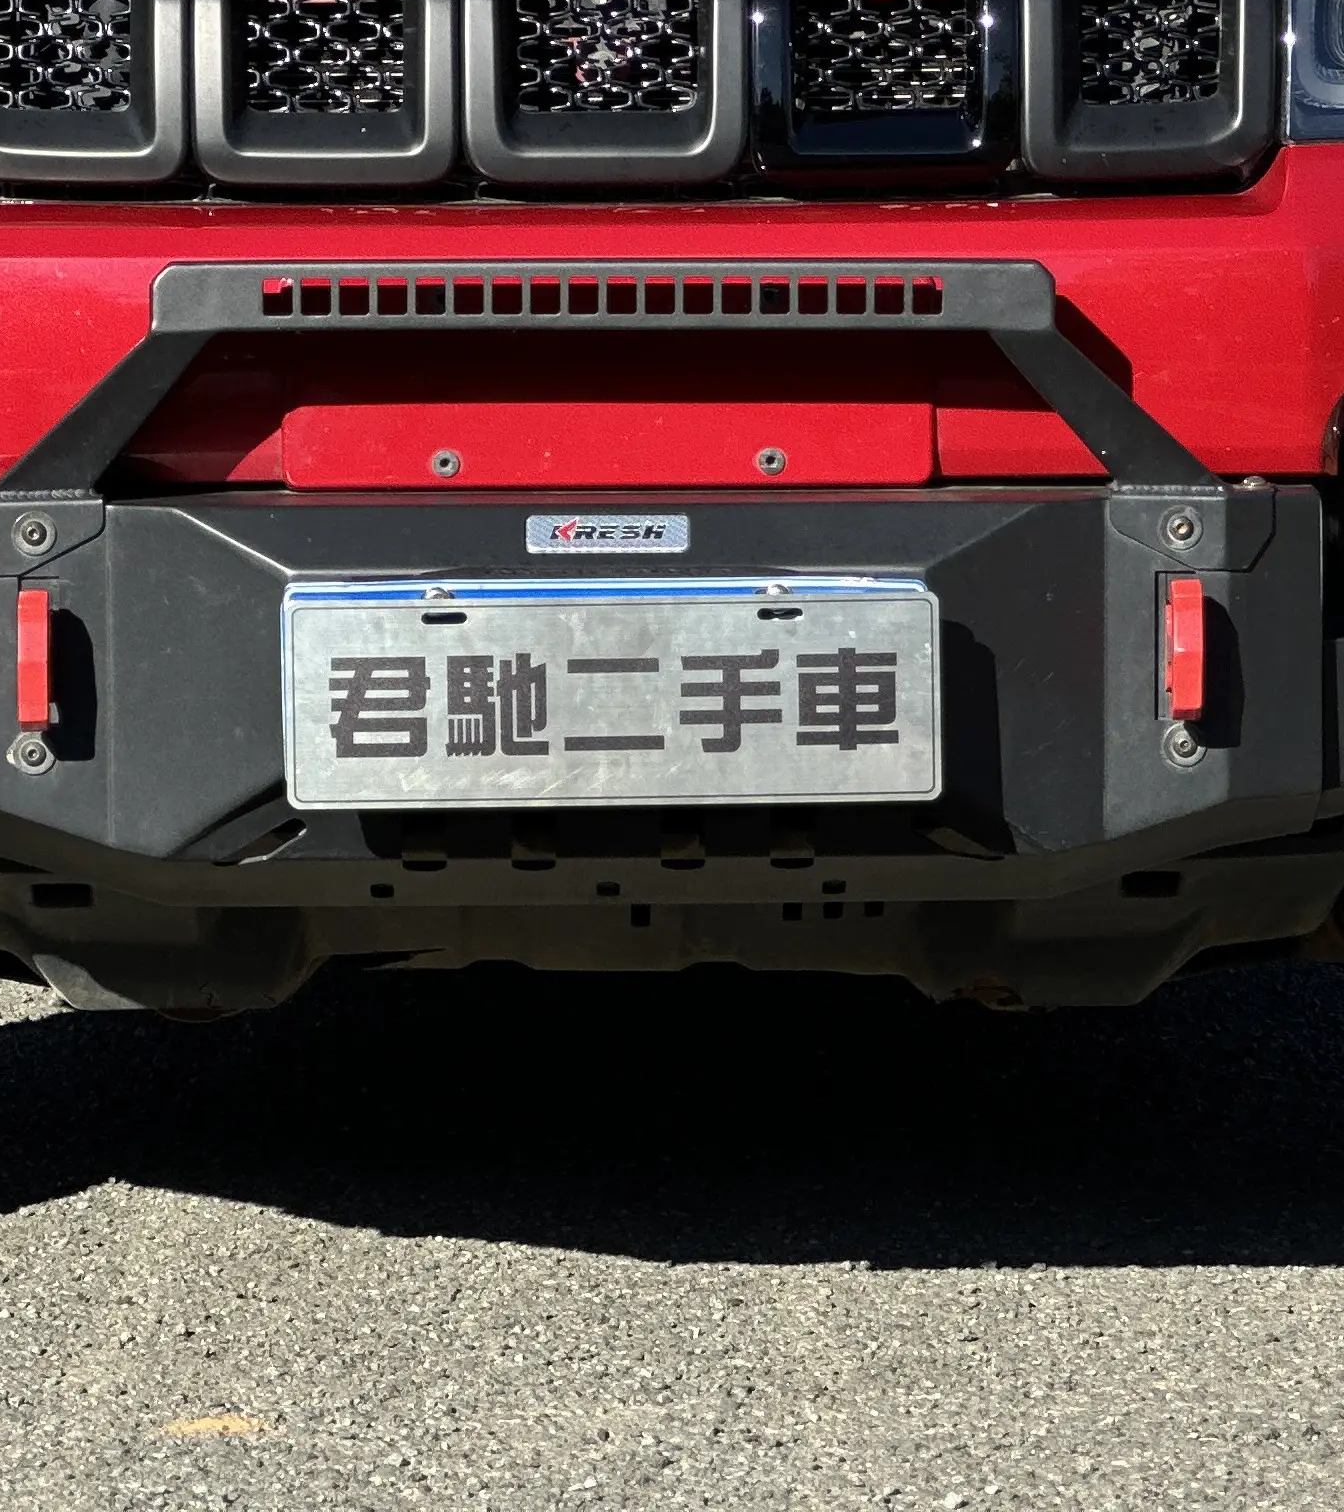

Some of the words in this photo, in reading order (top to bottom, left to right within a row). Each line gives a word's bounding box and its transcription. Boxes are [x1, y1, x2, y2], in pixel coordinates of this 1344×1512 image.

[328, 647, 899, 759] 君馳二手車
